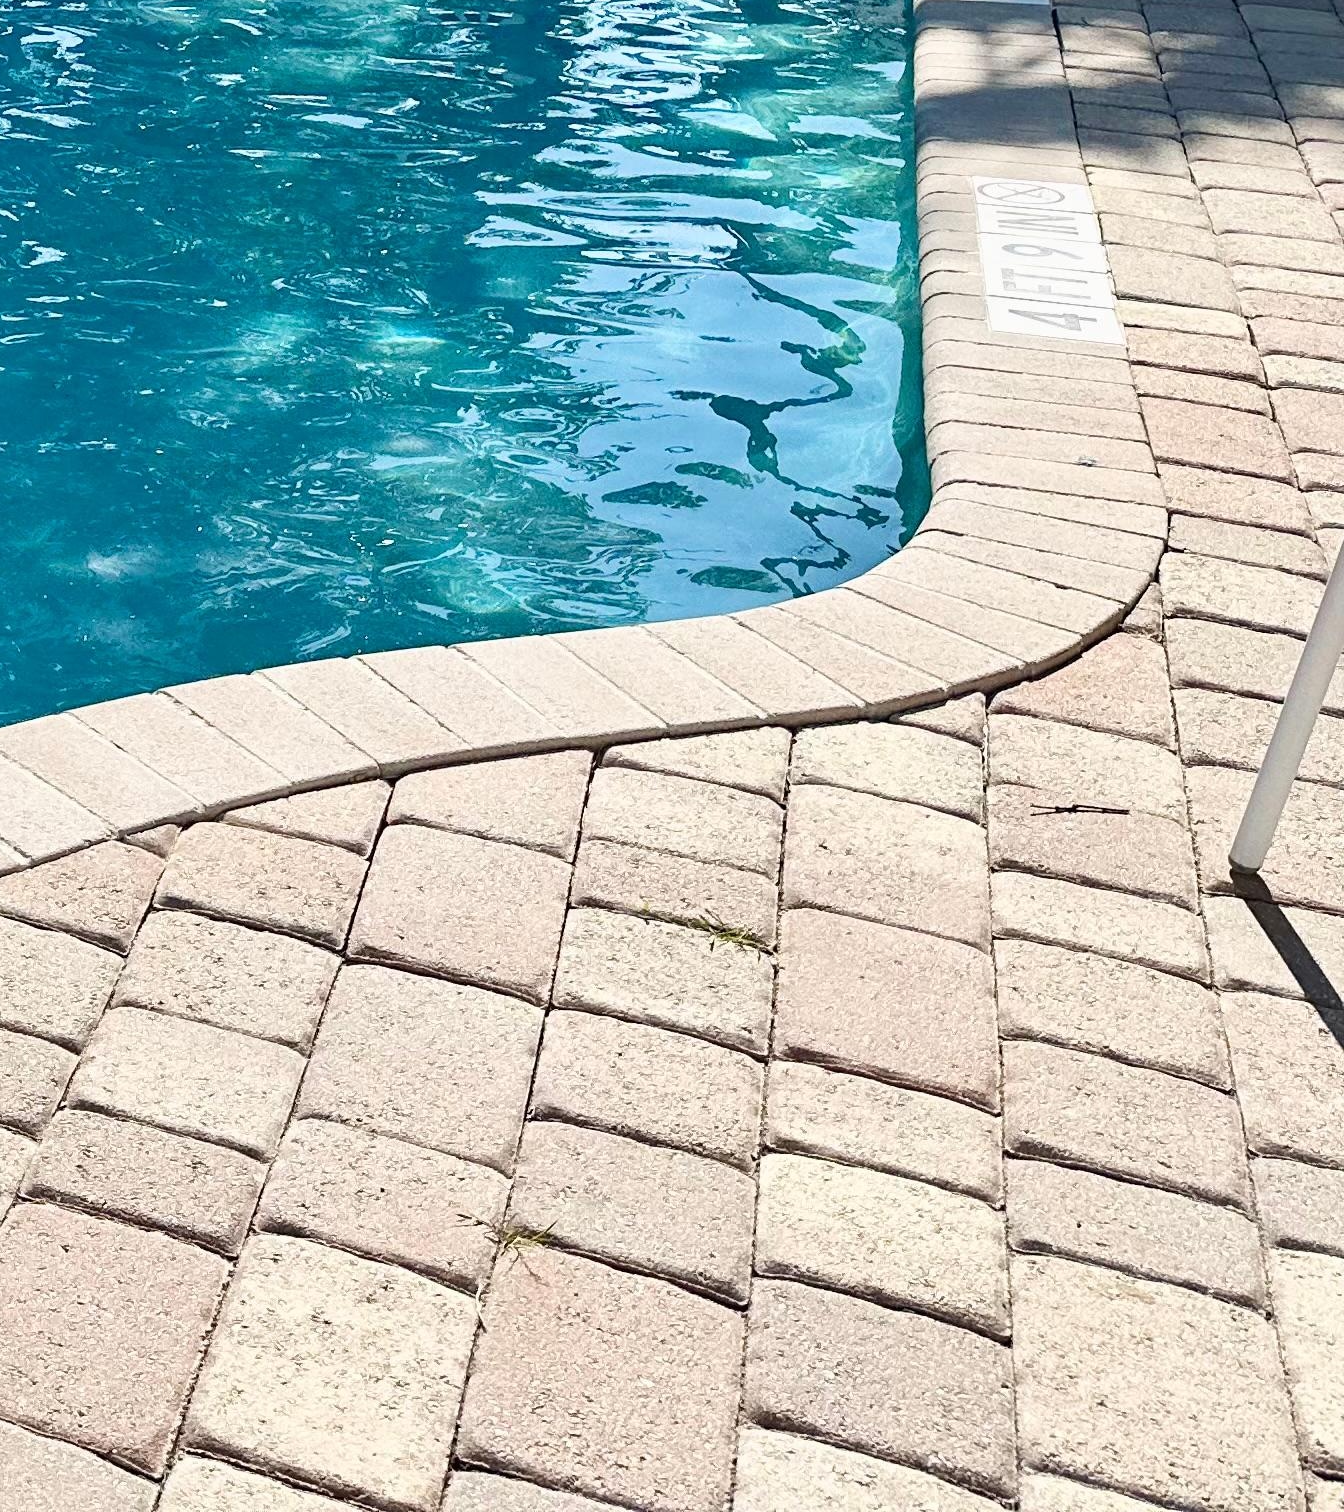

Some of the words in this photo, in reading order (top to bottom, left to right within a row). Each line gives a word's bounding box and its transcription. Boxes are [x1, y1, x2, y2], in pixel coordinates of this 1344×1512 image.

[996, 210, 1079, 235] IN
[1001, 268, 1091, 299] FT
[1008, 309, 1097, 332] 4
